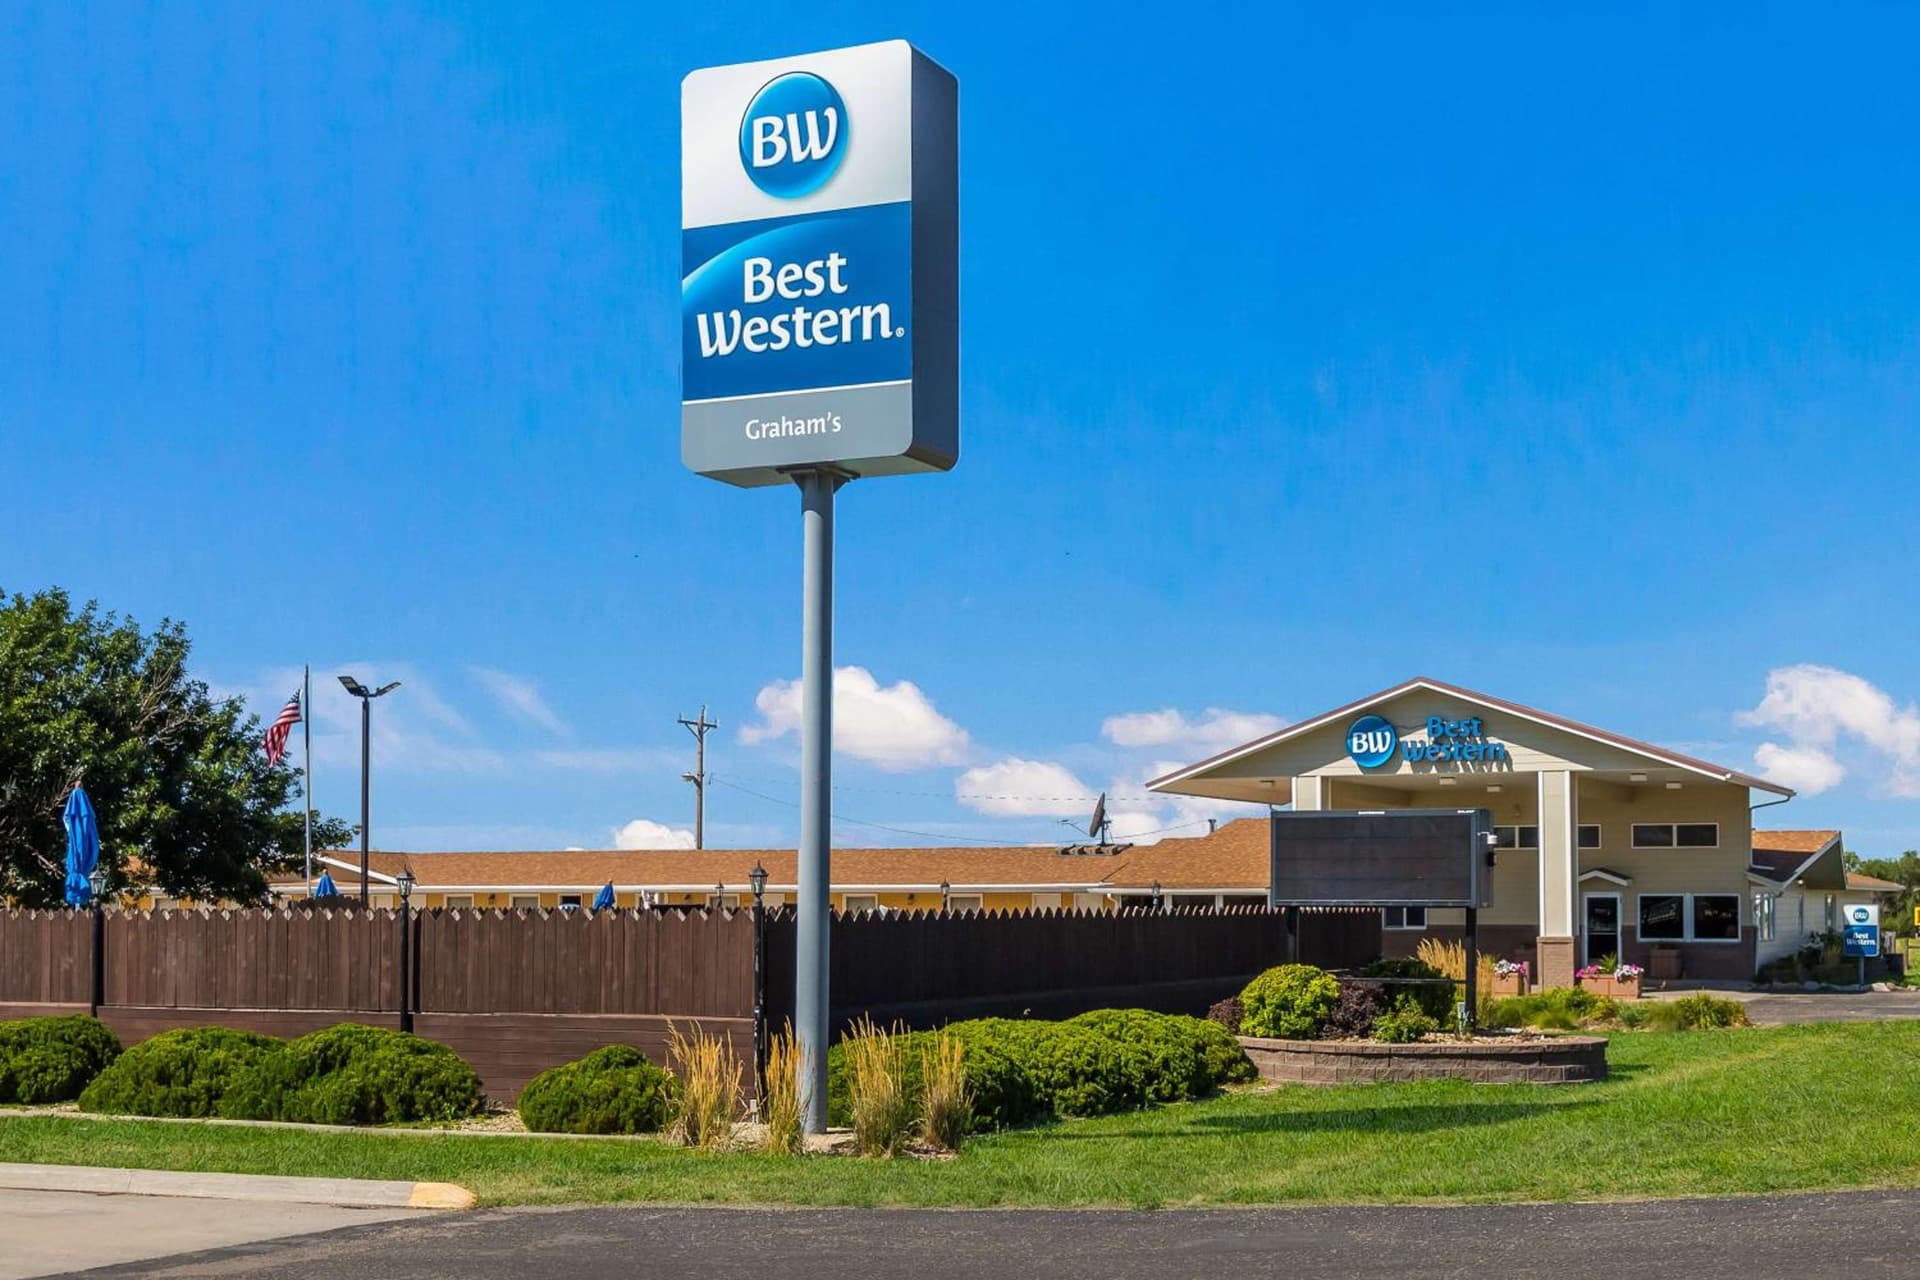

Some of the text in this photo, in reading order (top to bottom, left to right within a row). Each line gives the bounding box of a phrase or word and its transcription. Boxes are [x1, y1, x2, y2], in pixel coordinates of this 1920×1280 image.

[752, 107, 838, 168] BW
[744, 252, 848, 303] Best
[745, 412, 842, 440] Graham's
[1426, 715, 1483, 738] Best
[1352, 732, 1391, 754] BW
[1401, 738, 1506, 762] Western
